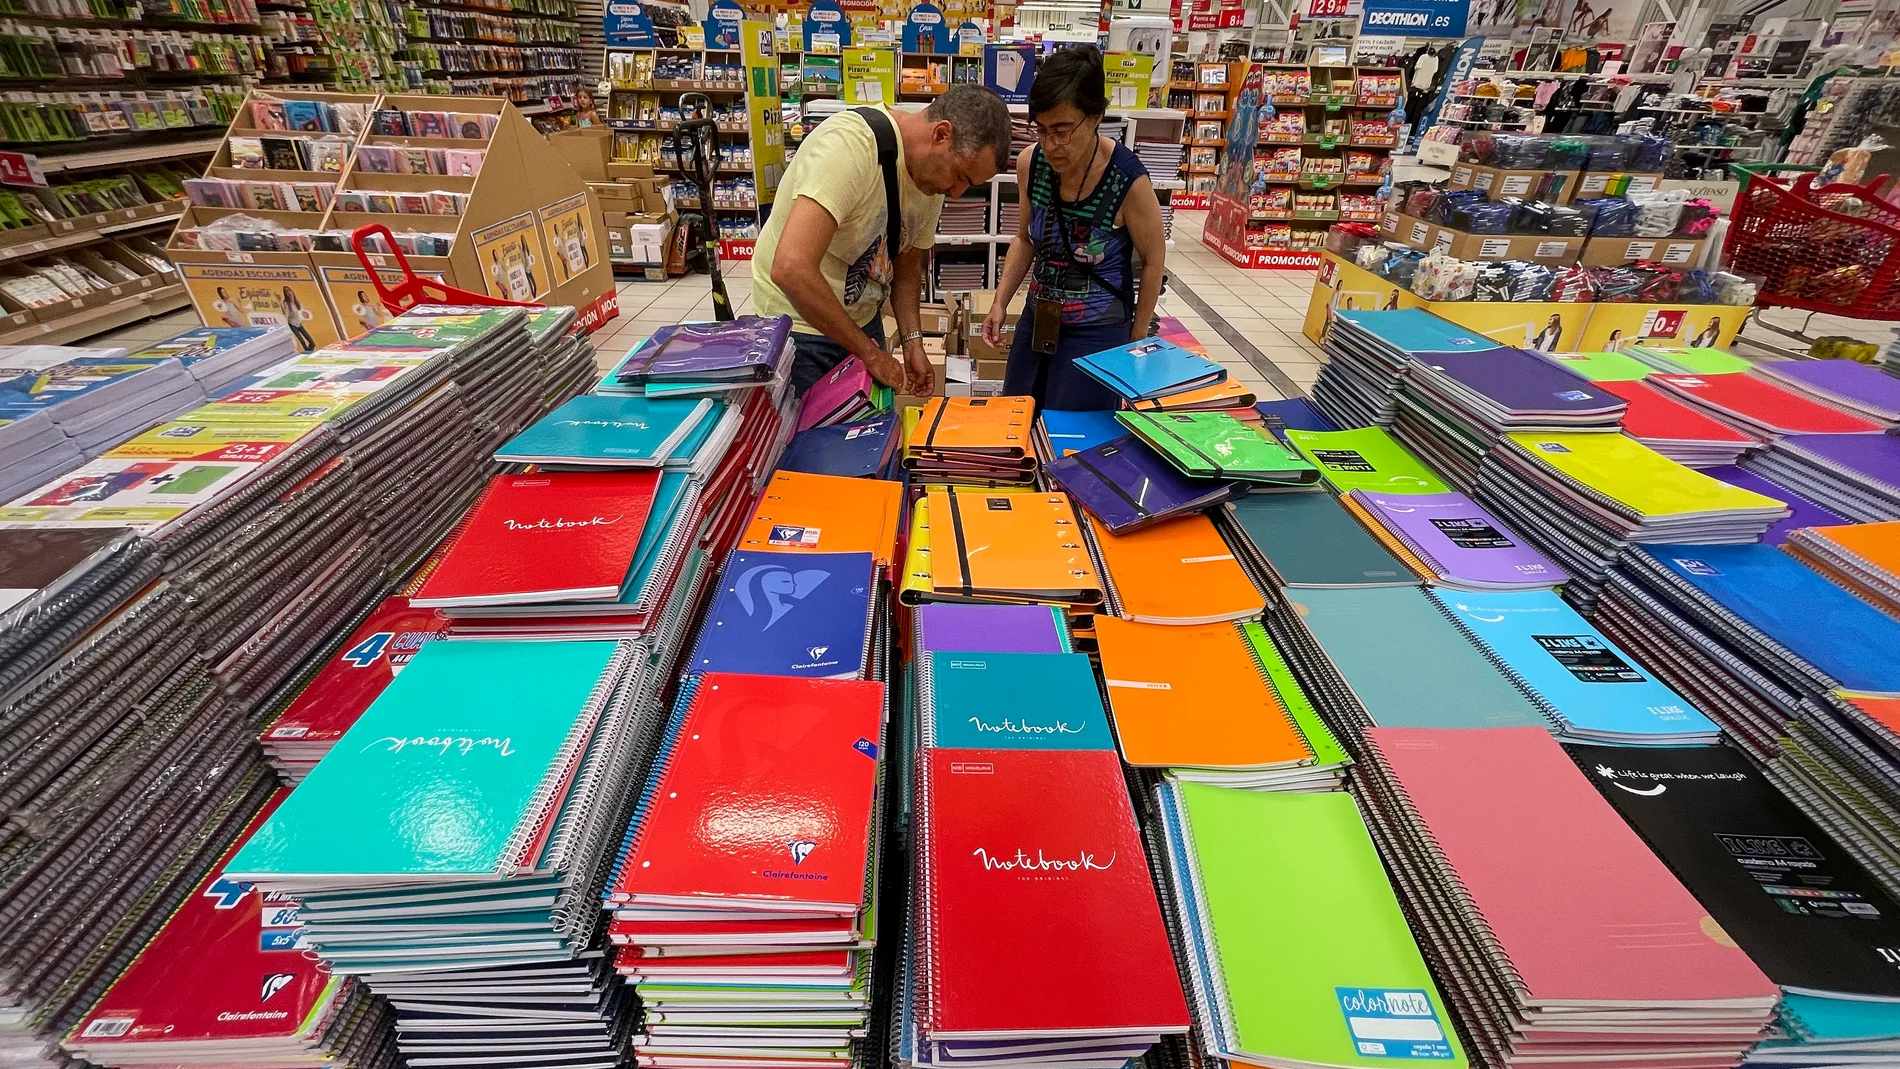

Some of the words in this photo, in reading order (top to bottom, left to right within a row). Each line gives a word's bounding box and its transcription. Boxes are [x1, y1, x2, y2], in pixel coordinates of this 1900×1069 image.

[1369, 12, 1429, 27] DECATHLON
[1430, 15, 1451, 28] .es
[847, 66, 870, 74] Pizarra
[733, 246, 754, 256] PRO
[1222, 243, 1250, 264] PROMOCIÓN
[1258, 253, 1321, 266] PROMOCIÓN
[201, 269, 244, 278] AGENDAS
[245, 270, 298, 279] ESCOLARES
[253, 300, 270, 311] para
[271, 300, 280, 308] la
[601, 297, 618, 315] MOC
[575, 310, 598, 326] OCIÓN
[219, 444, 275, 455] 3+1
[1548, 638, 1582, 648] LIKE
[341, 632, 396, 668] 4
[791, 659, 839, 670] Clairefontaine
[1649, 772, 1674, 781] great
[1716, 771, 1747, 781] laugh
[762, 870, 829, 881] Clairefontaine
[271, 935, 290, 946] 5x5
[1343, 989, 1429, 1014] colornote
[217, 1009, 288, 1022] Clairefontaine
